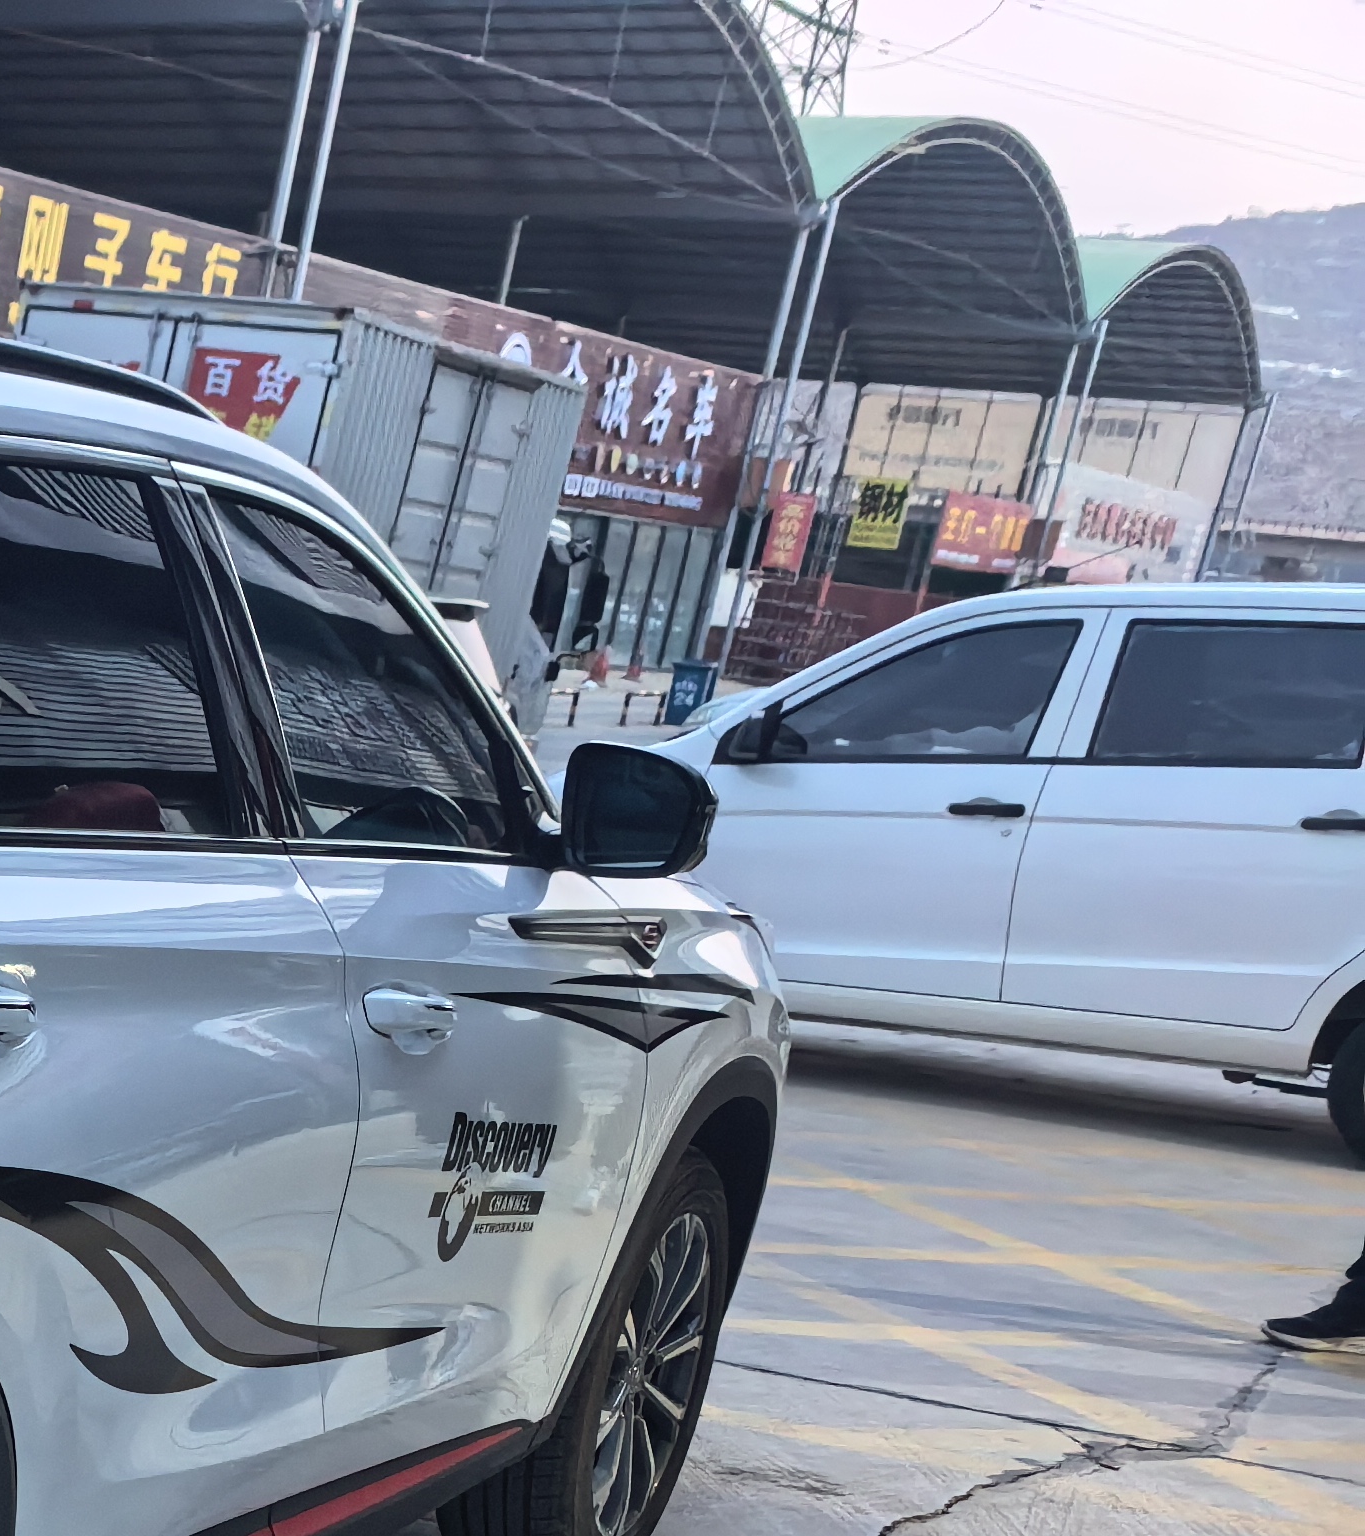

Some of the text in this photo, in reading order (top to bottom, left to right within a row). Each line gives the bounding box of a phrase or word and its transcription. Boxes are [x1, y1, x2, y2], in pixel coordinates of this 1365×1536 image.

[203, 355, 293, 405] 百货
[488, 1194, 532, 1215] CHANNEL
[472, 1220, 535, 1235] NETWORKS ASIA
